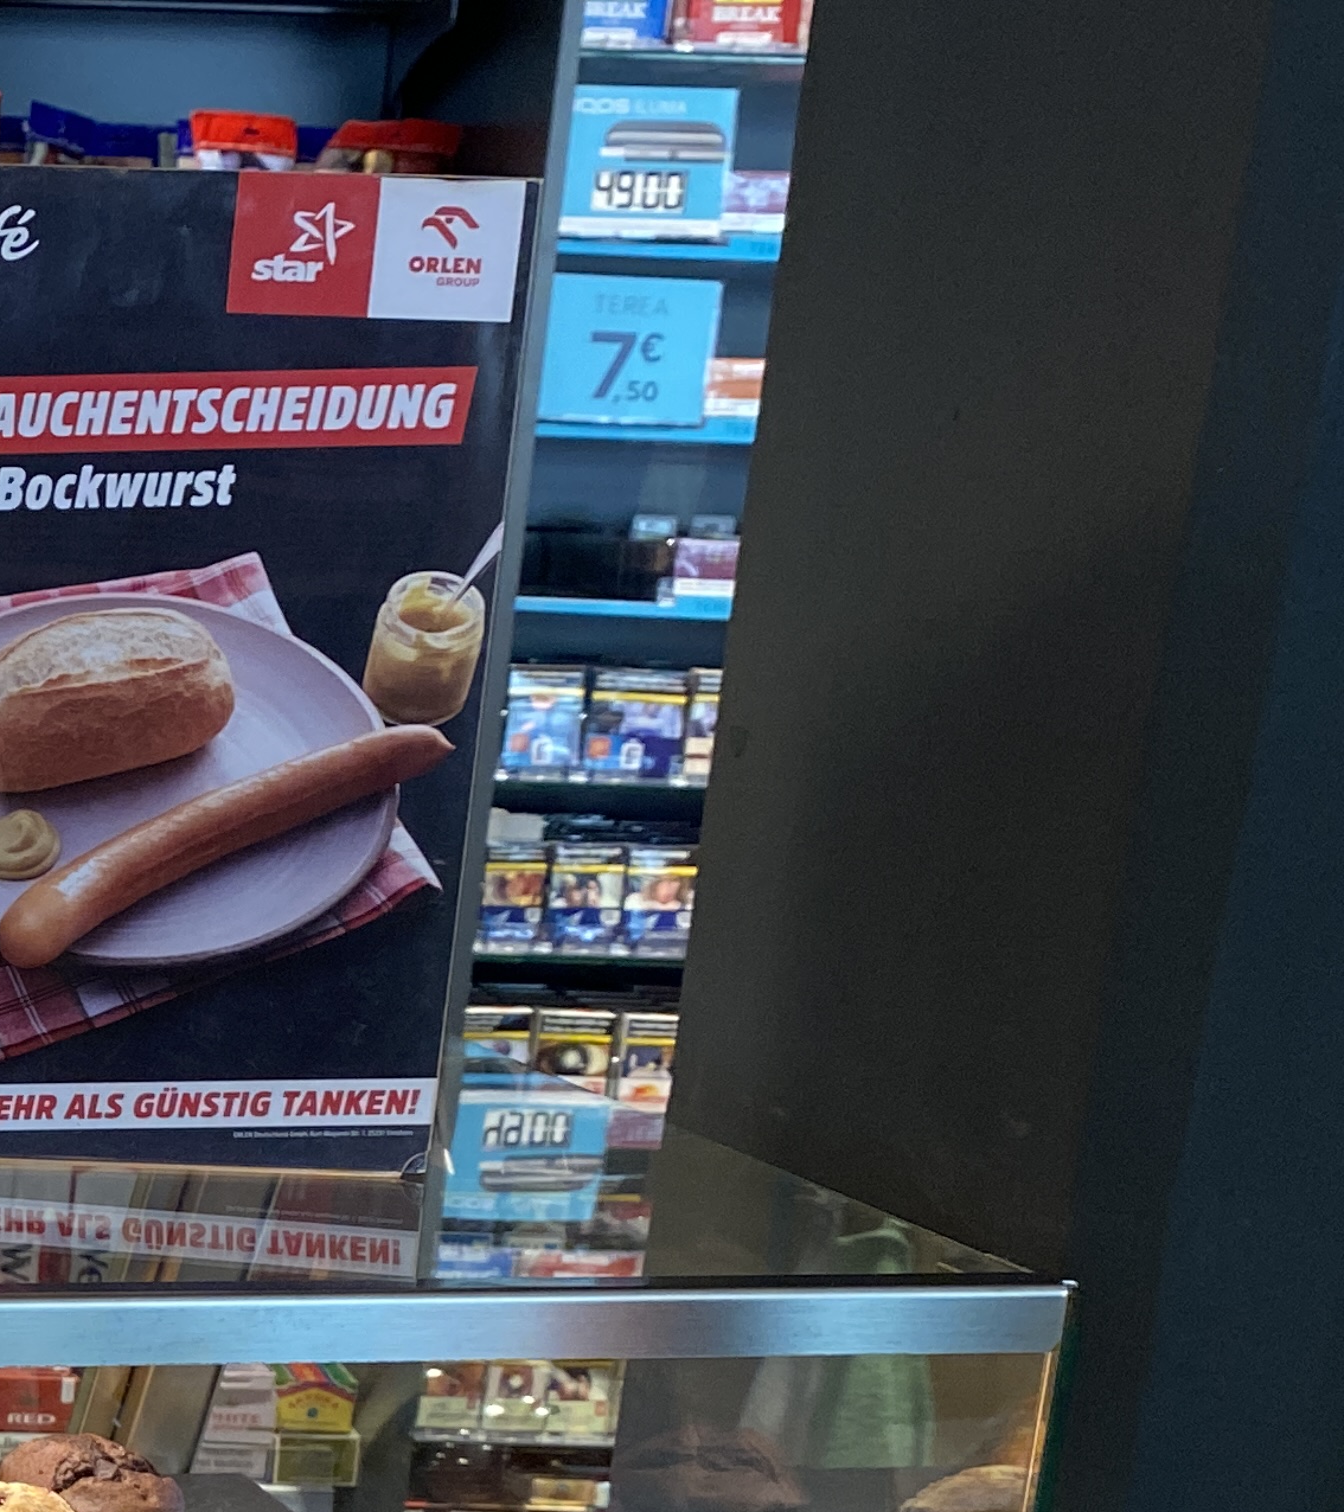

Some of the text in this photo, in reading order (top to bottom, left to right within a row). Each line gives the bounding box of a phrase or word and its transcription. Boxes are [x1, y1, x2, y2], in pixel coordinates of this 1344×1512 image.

[250, 254, 323, 284] star
[408, 256, 482, 275] ORLEN
[435, 276, 480, 288] GROUP
[591, 330, 637, 400] 7
[63, 1091, 124, 1120] ALS
[134, 1085, 269, 1120] GÜNSTIG
[280, 1088, 421, 1118] TANKEN!
